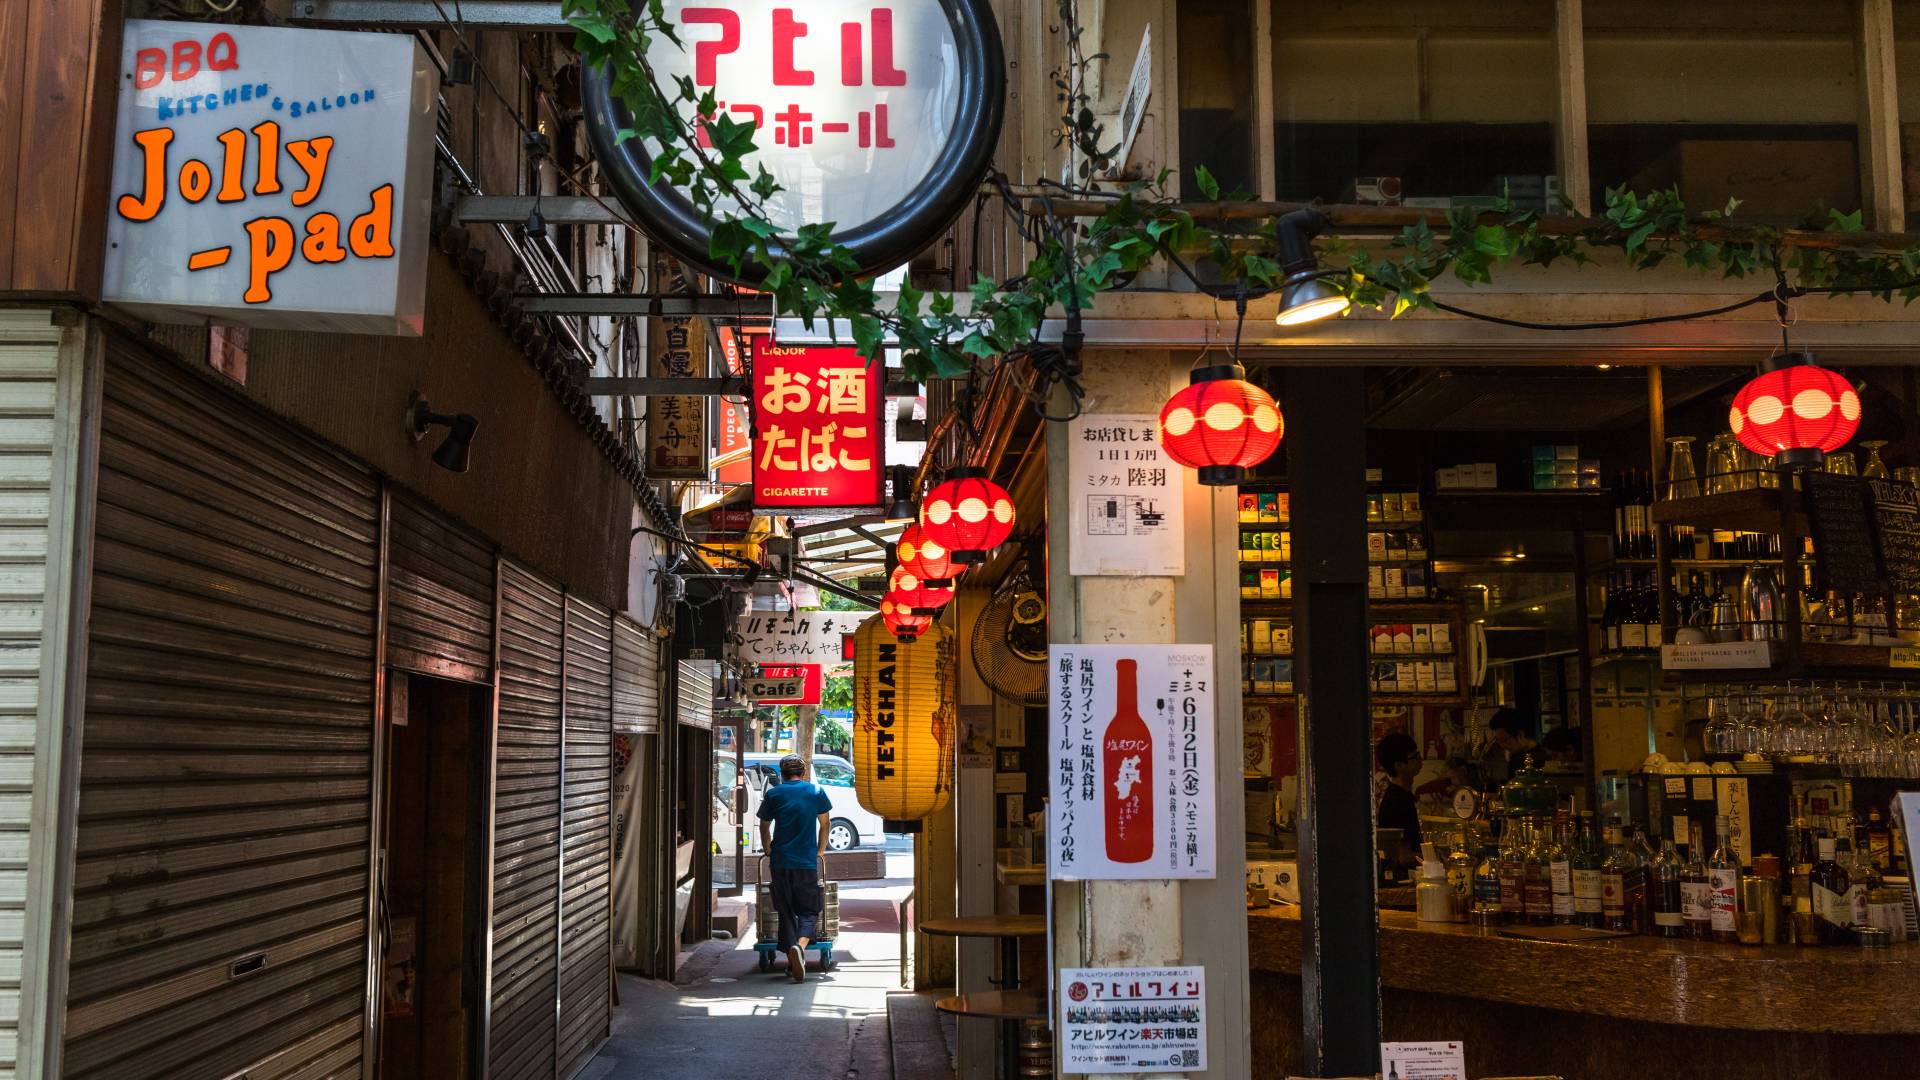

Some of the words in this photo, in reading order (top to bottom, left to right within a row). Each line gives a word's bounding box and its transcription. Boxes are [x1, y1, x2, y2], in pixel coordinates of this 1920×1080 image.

[134, 32, 240, 91] BBQ
[681, 7, 906, 87] アヒル
[157, 83, 269, 121] KITCHEN
[271, 97, 283, 111] &
[289, 88, 376, 119] SALOON
[117, 120, 335, 223] Jolly
[187, 182, 396, 304] -pad
[761, 346, 806, 357] LIQUOR
[761, 366, 867, 415] お酒
[658, 396, 686, 449] 美舟
[726, 408, 736, 447] VIDEO
[1083, 427, 1159, 442] お店貸しま
[759, 421, 872, 473] たばこ
[1098, 449, 1157, 462] 1日1万円
[762, 487, 829, 498] CIGARETTE
[1087, 474, 1121, 488] ミタカ
[1127, 468, 1167, 488] 陸羽
[752, 682, 797, 696] Café
[771, 667, 809, 678] ハモカ
[877, 644, 897, 780] TETCHAN
[1079, 657, 1096, 801] 塩尻ワインと塩尻食材
[1181, 697, 1200, 798] 6月2日(金)
[614, 784, 630, 793] 020
[1184, 801, 1199, 868] ハモニカ横丁
[1091, 981, 1200, 998] アヒルワイン
[1071, 1027, 1198, 1041] アヒルワイン楽天市場店
